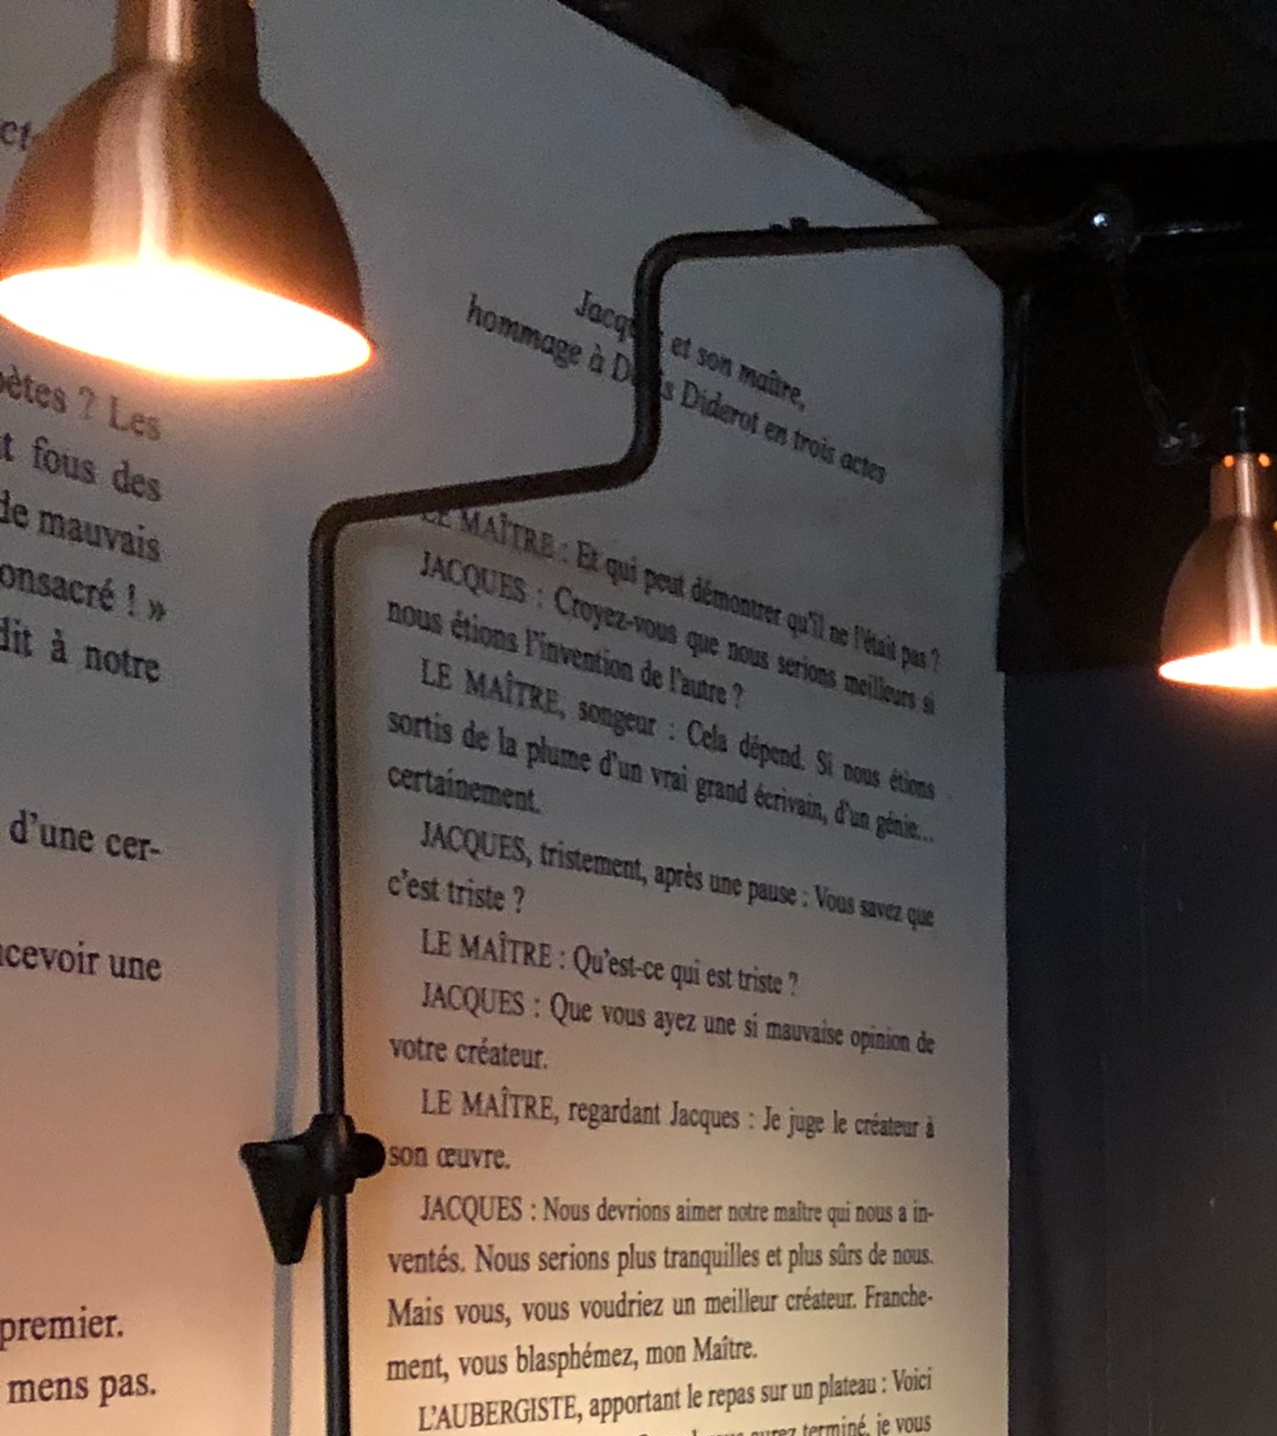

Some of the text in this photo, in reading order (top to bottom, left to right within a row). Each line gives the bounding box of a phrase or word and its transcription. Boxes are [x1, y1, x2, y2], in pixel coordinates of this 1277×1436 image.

[109, 395, 161, 440] Les
[682, 380, 761, 436] Diderot
[32, 435, 161, 501] fous des
[38, 508, 161, 562] mauvais
[51, 628, 161, 684] à notre
[386, 764, 541, 815] certainement.
[9, 809, 162, 861] d'une cer-
[419, 819, 797, 906] JACQUES, tristement, après une pause
[386, 866, 506, 912] c'est triste
[109, 953, 162, 981] une
[420, 926, 783, 995] LE MAÎTRE Qu'est-ce qui est triste
[420, 980, 911, 1055] JACQUES Que vous ayez une si mauvaise opinion
[387, 1035, 548, 1070] votre créateur.
[420, 1084, 935, 1140] LE MAÎTRE, regardant Jacques Je juge le créateur à
[387, 1143, 511, 1170] son œuvre.
[419, 1193, 935, 1229] JACQUES Nous devrions aimer notre maître qui nous a in-
[386, 1240, 934, 1278] ventés. Nous serions plus tranquilles et plus sûrs de nous.
[0, 1305, 124, 1350] premier.
[386, 1282, 934, 1328] Mais vous, vous voudriez un meilleur créateur. Franche-
[385, 1333, 758, 1383] ment, vous blasphémez, mon Maître.
[7, 1372, 157, 1408] mens pas.
[417, 1365, 932, 1432] L'AUBERGISTE, apportant le repas sur un plateau Voici
[894, 1413, 932, 1434] vous
